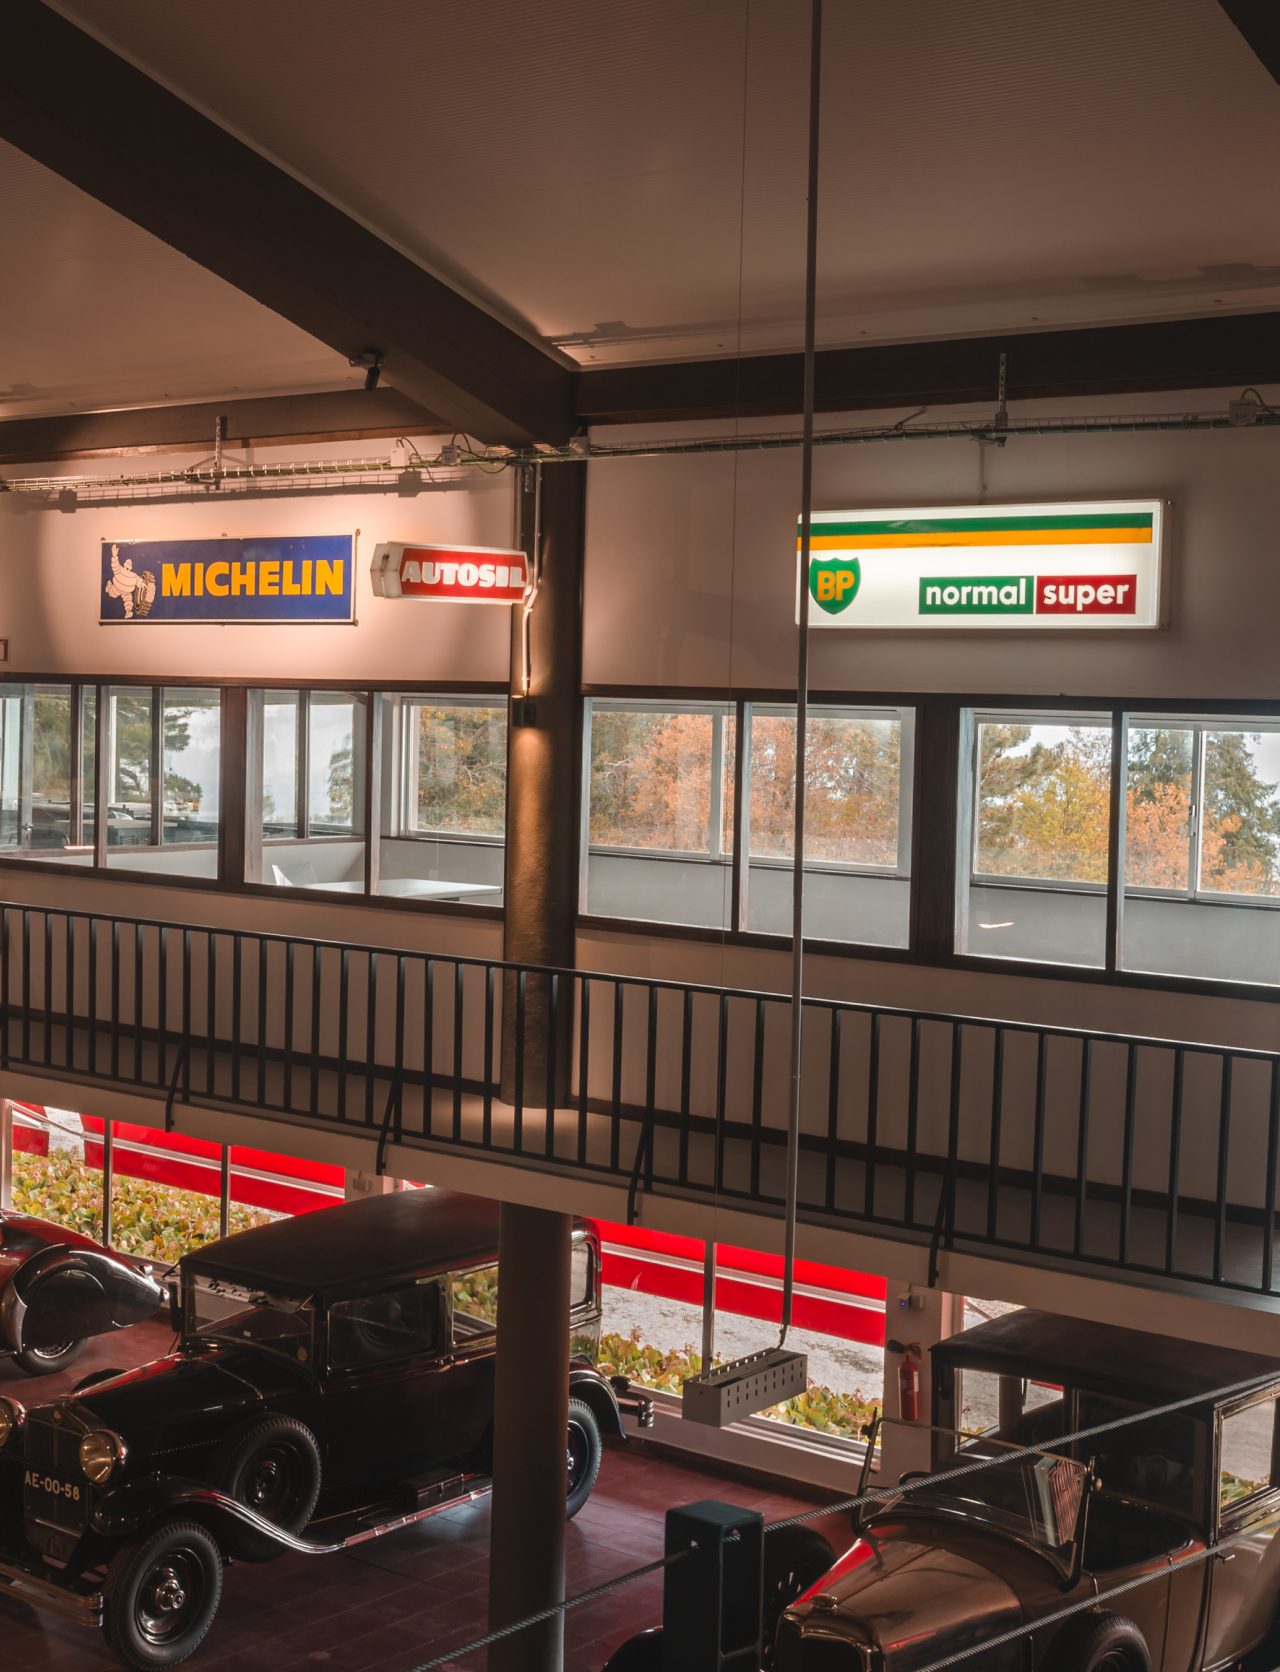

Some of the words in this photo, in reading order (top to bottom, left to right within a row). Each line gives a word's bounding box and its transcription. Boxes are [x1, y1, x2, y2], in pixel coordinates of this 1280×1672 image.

[161, 559, 345, 597] MICHELIN
[401, 560, 527, 589] AUTOSIL
[816, 570, 855, 602] BP
[925, 577, 1026, 606] normal
[1042, 582, 1130, 612] super
[24, 1470, 80, 1500] AE-00-58
